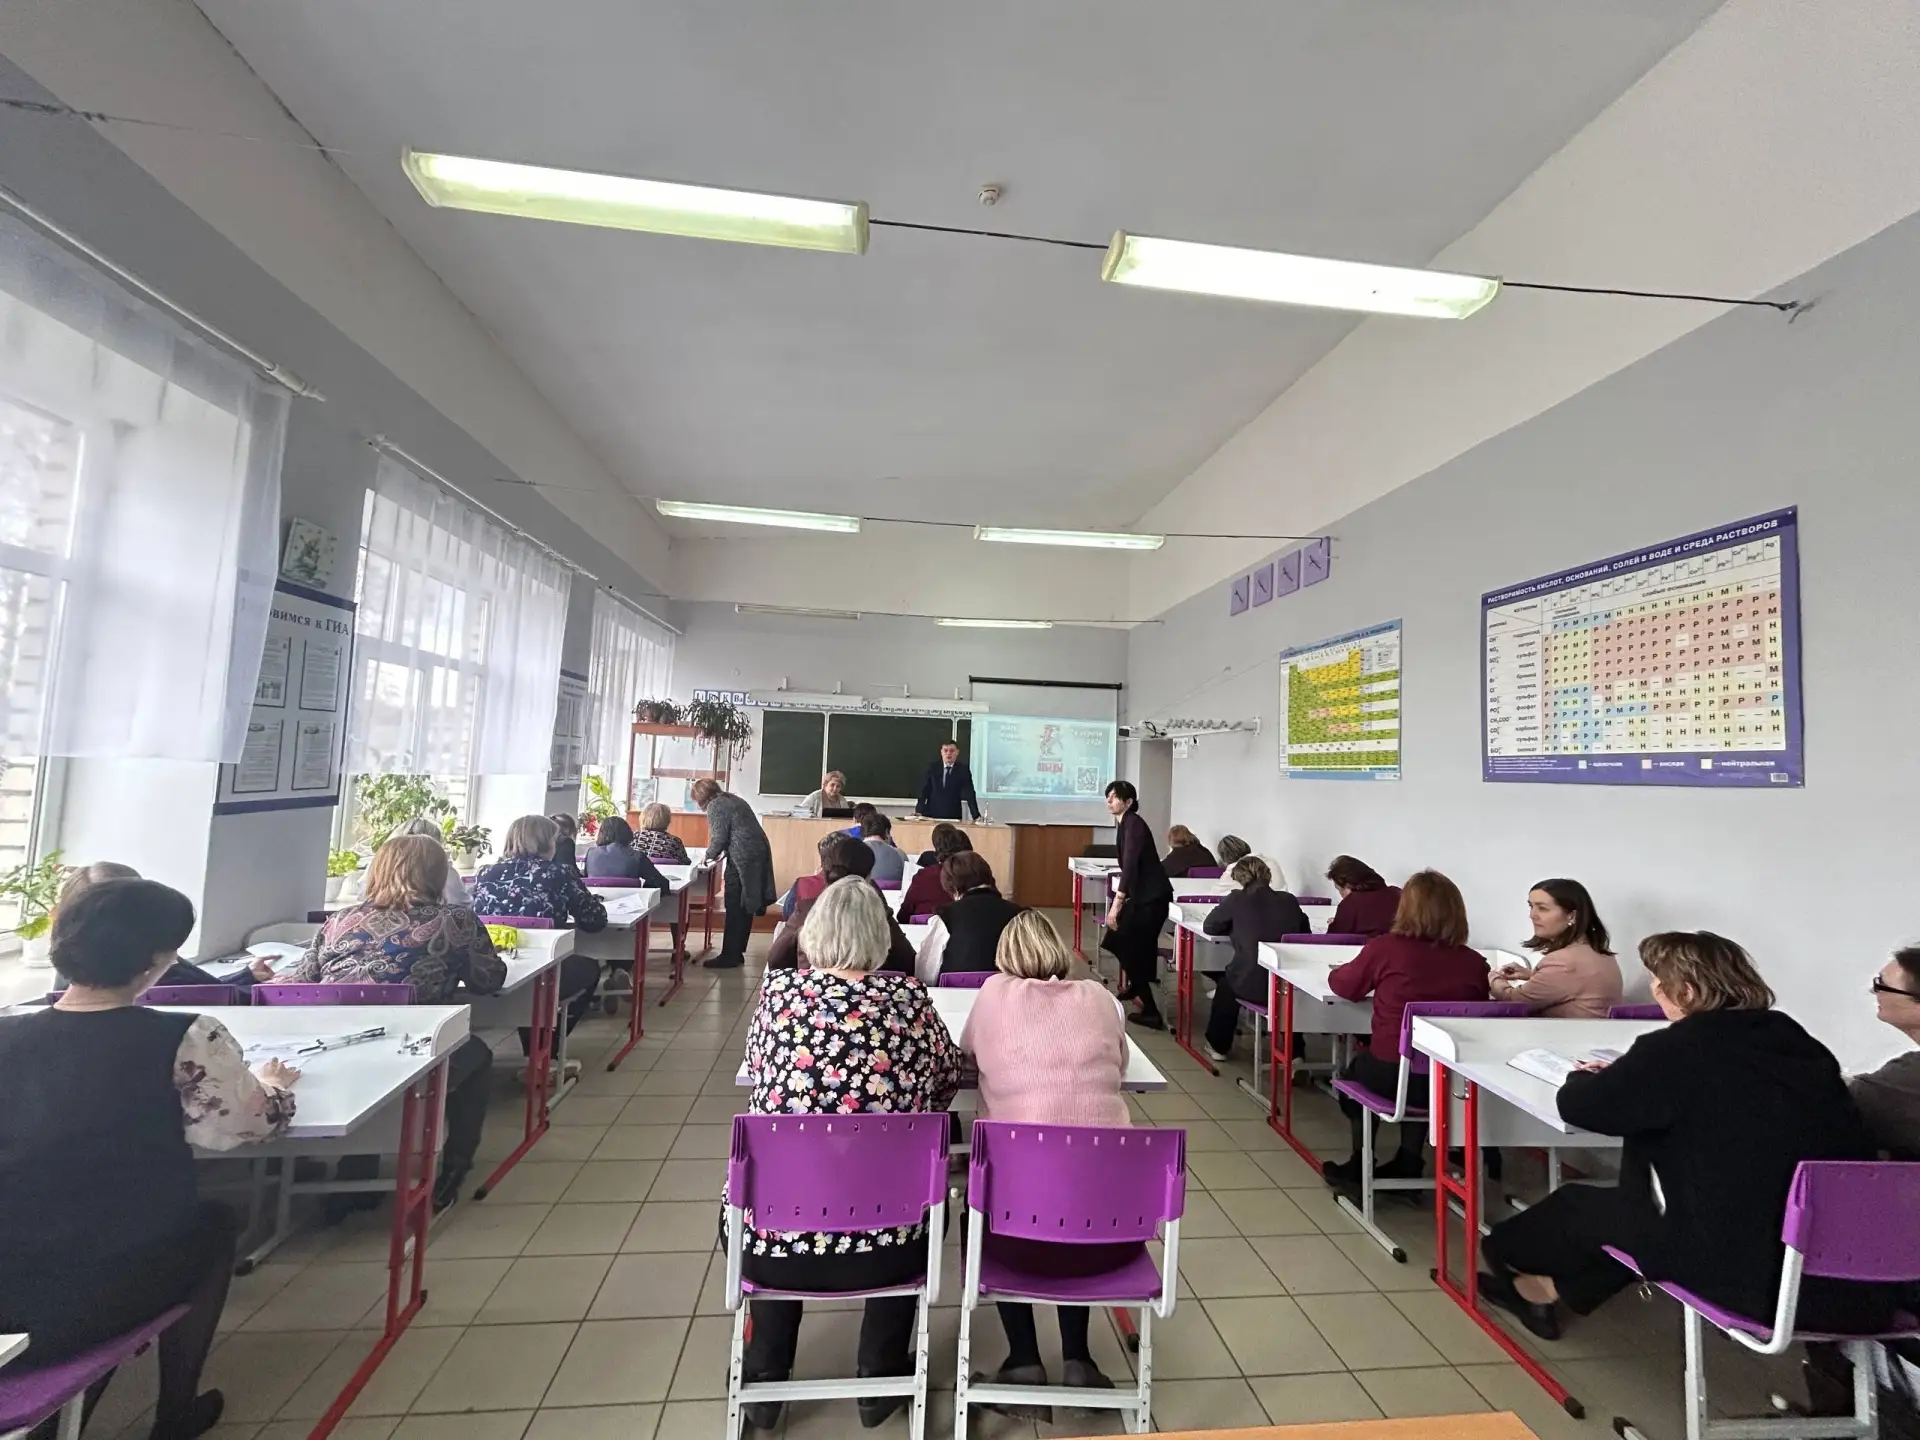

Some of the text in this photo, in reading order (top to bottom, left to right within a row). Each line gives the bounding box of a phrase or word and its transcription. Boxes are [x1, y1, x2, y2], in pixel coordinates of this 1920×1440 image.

[1487, 586, 1536, 604] РАСТВОРИМОСТЬ
[1536, 578, 1564, 591] КИСЛОТ,
[1566, 565, 1612, 582] ОСНОВАНИЙ,
[1613, 556, 1640, 570] СОЛЕЙ
[1641, 554, 1647, 562] В
[1649, 548, 1672, 560] ВОДЕ
[1674, 544, 1680, 553] И
[1682, 536, 1714, 551] СРЕДА
[1716, 519, 1778, 542] РАСТВОРОВ
[316, 620, 322, 629] к
[325, 618, 349, 636] ГИА
